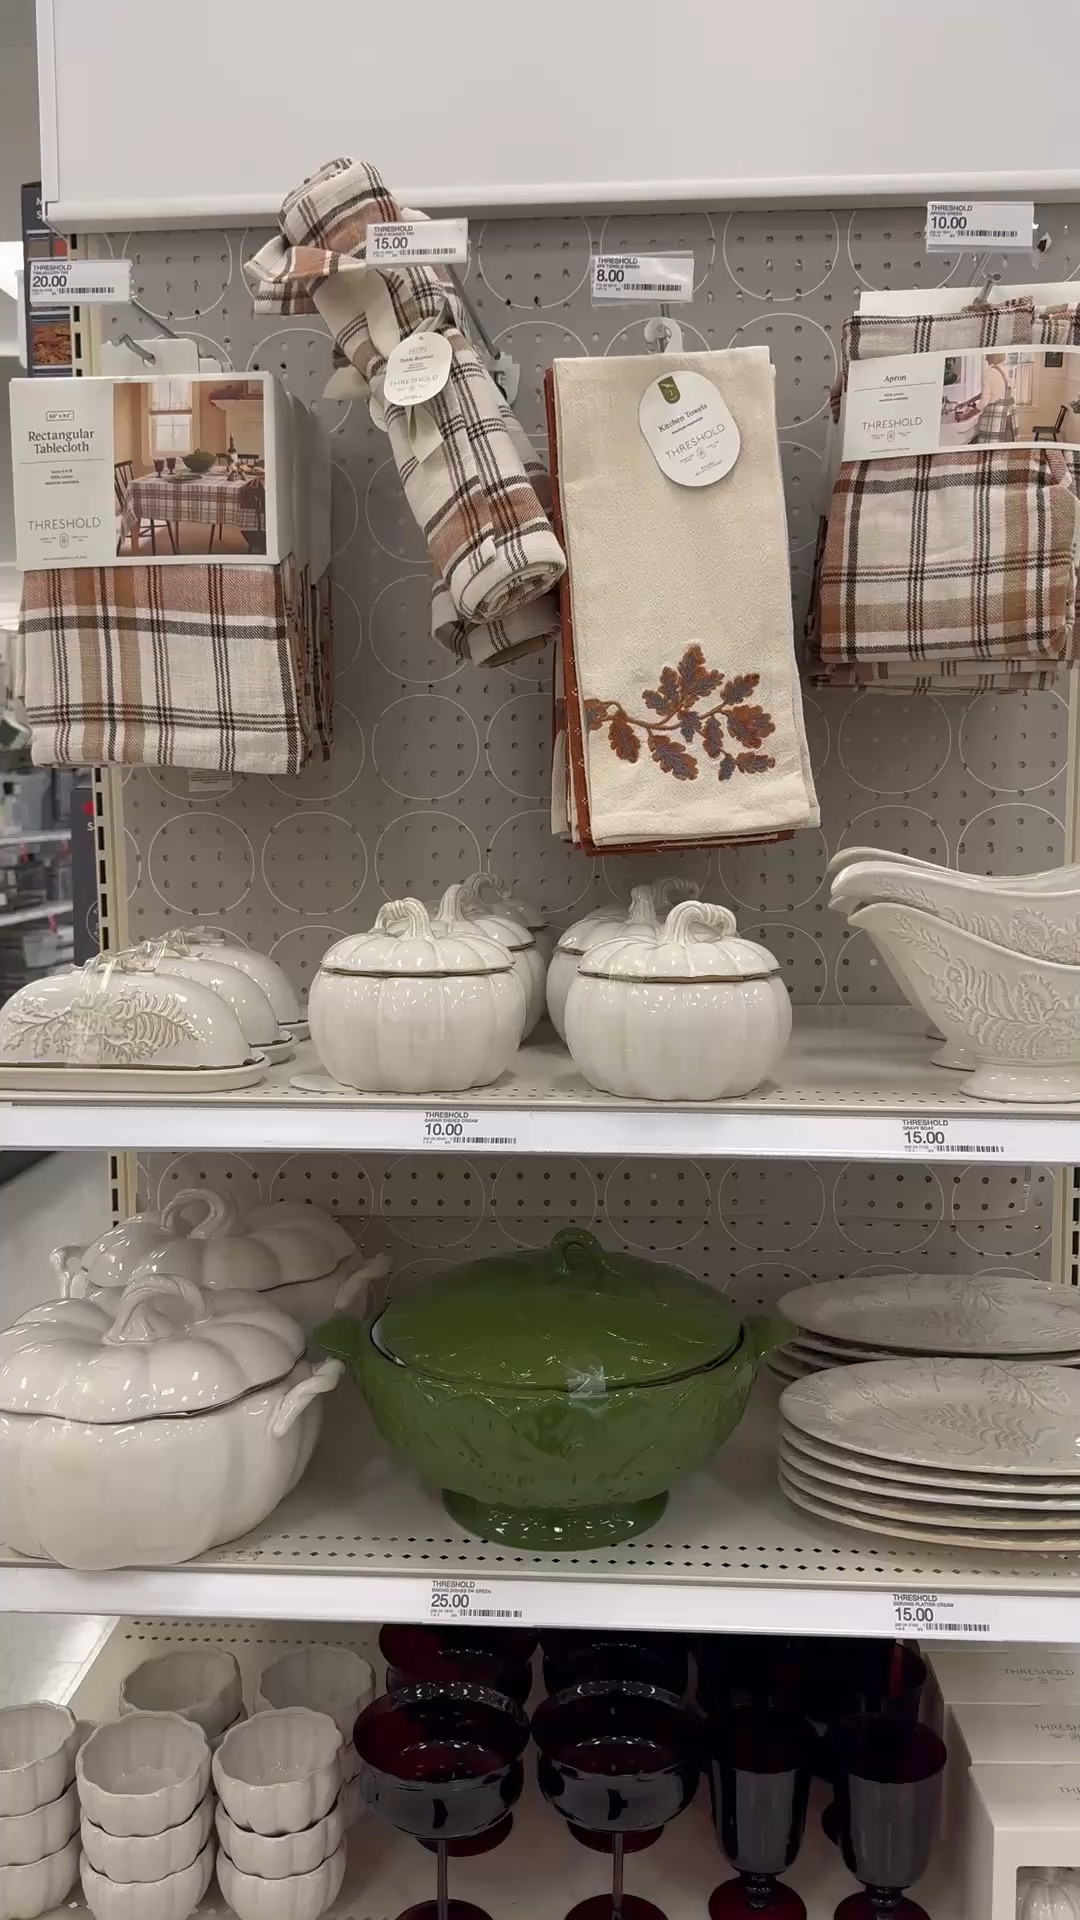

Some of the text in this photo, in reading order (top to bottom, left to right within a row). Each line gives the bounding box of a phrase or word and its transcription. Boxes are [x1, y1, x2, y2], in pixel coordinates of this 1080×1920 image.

[931, 216, 967, 229] 10.00
[374, 237, 408, 249] 15.00
[33, 275, 67, 287] 20.00
[596, 269, 625, 282] 8.00
[390, 374, 438, 386] THRESHOLD
[884, 375, 907, 383] Apron
[658, 415, 685, 433] Kitchen
[685, 404, 708, 418] Towels
[862, 417, 923, 431] THRESHOLD
[28, 428, 95, 442] Rectangular
[665, 423, 725, 459] THRESHOLD
[33, 442, 89, 454] Tablecloth
[28, 517, 101, 531] THRESHOLD
[425, 1123, 463, 1136] 10.00
[904, 1131, 945, 1144] 15.00
[432, 1580, 475, 1588] THRESHOLD
[431, 1593, 469, 1608] 25.00
[893, 1594, 937, 1602] THRESHOLD
[895, 1607, 934, 1622] 15.00
[1004, 1668, 1075, 1676] THRESHOLD
